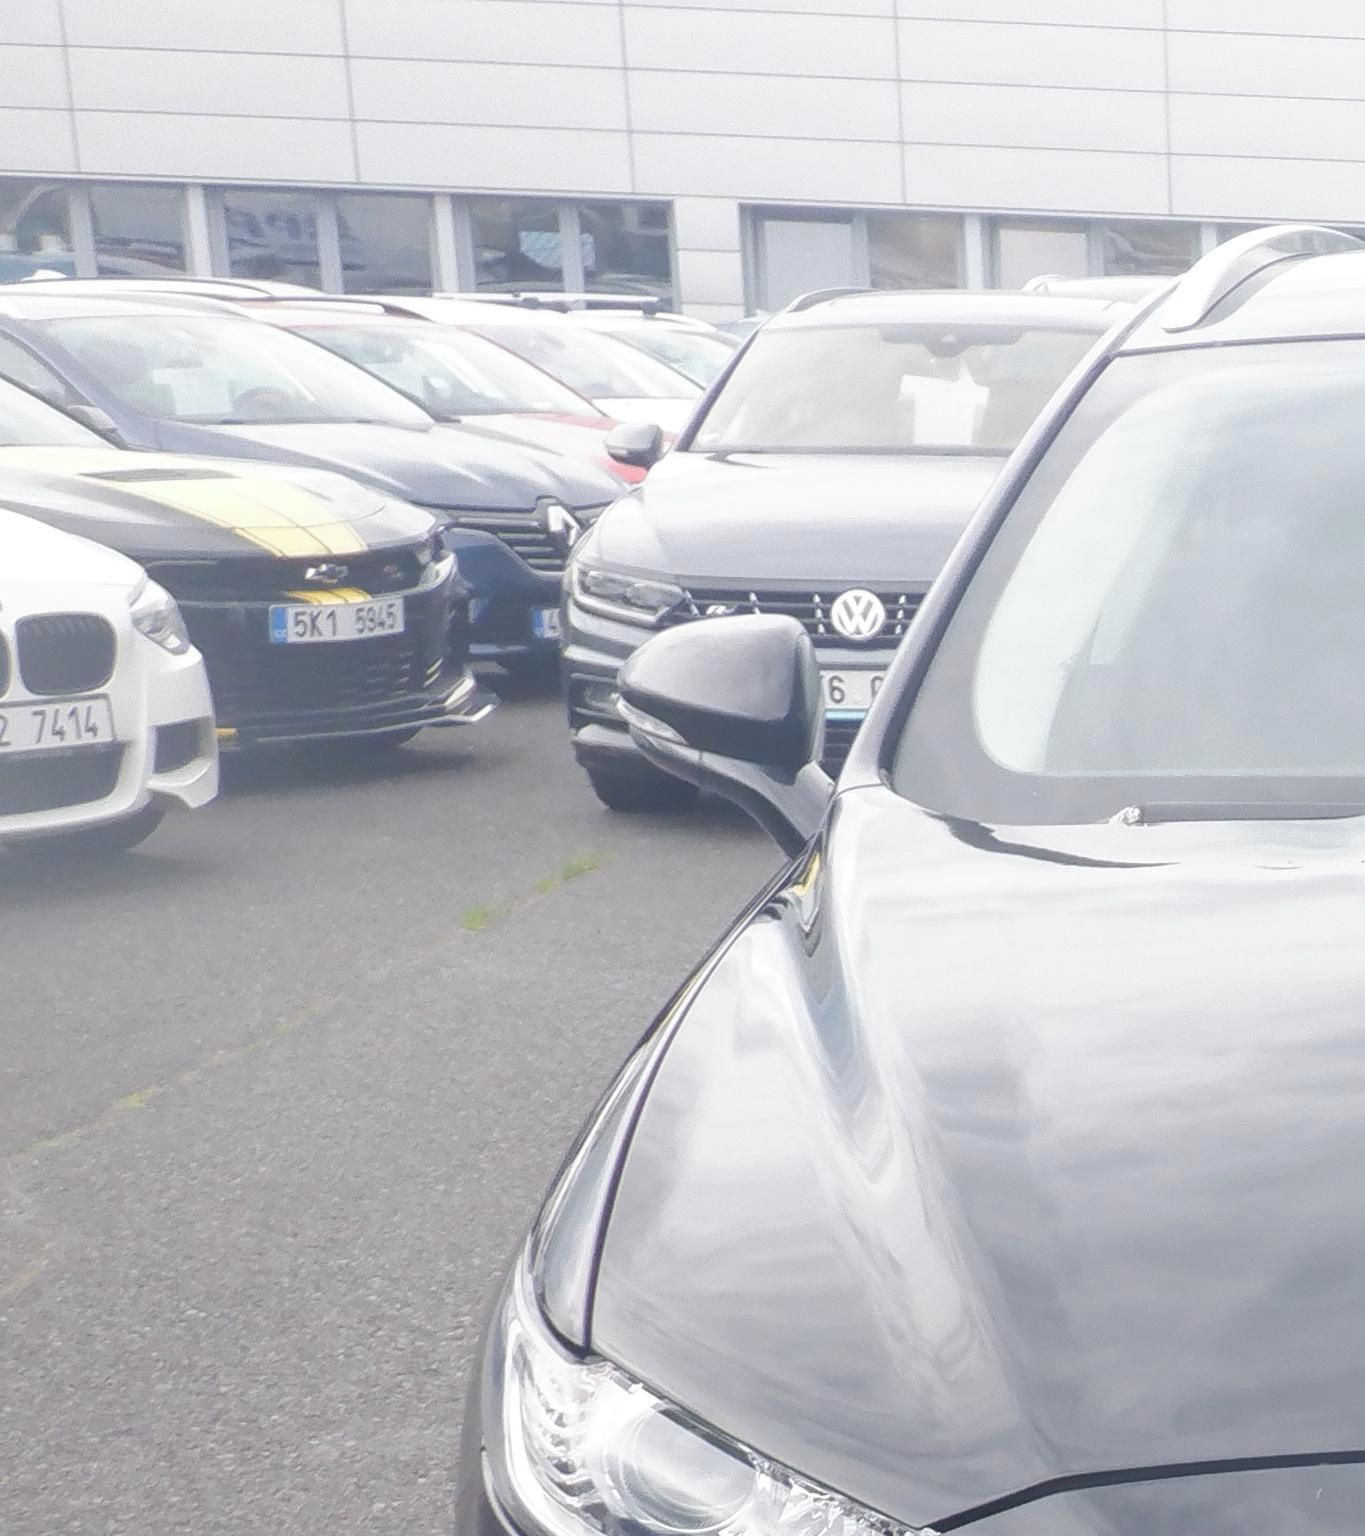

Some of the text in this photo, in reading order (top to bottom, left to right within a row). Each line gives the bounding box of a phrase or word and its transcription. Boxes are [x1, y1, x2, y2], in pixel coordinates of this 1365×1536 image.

[294, 602, 397, 638] 5K1 5945
[32, 704, 98, 745] 7414
